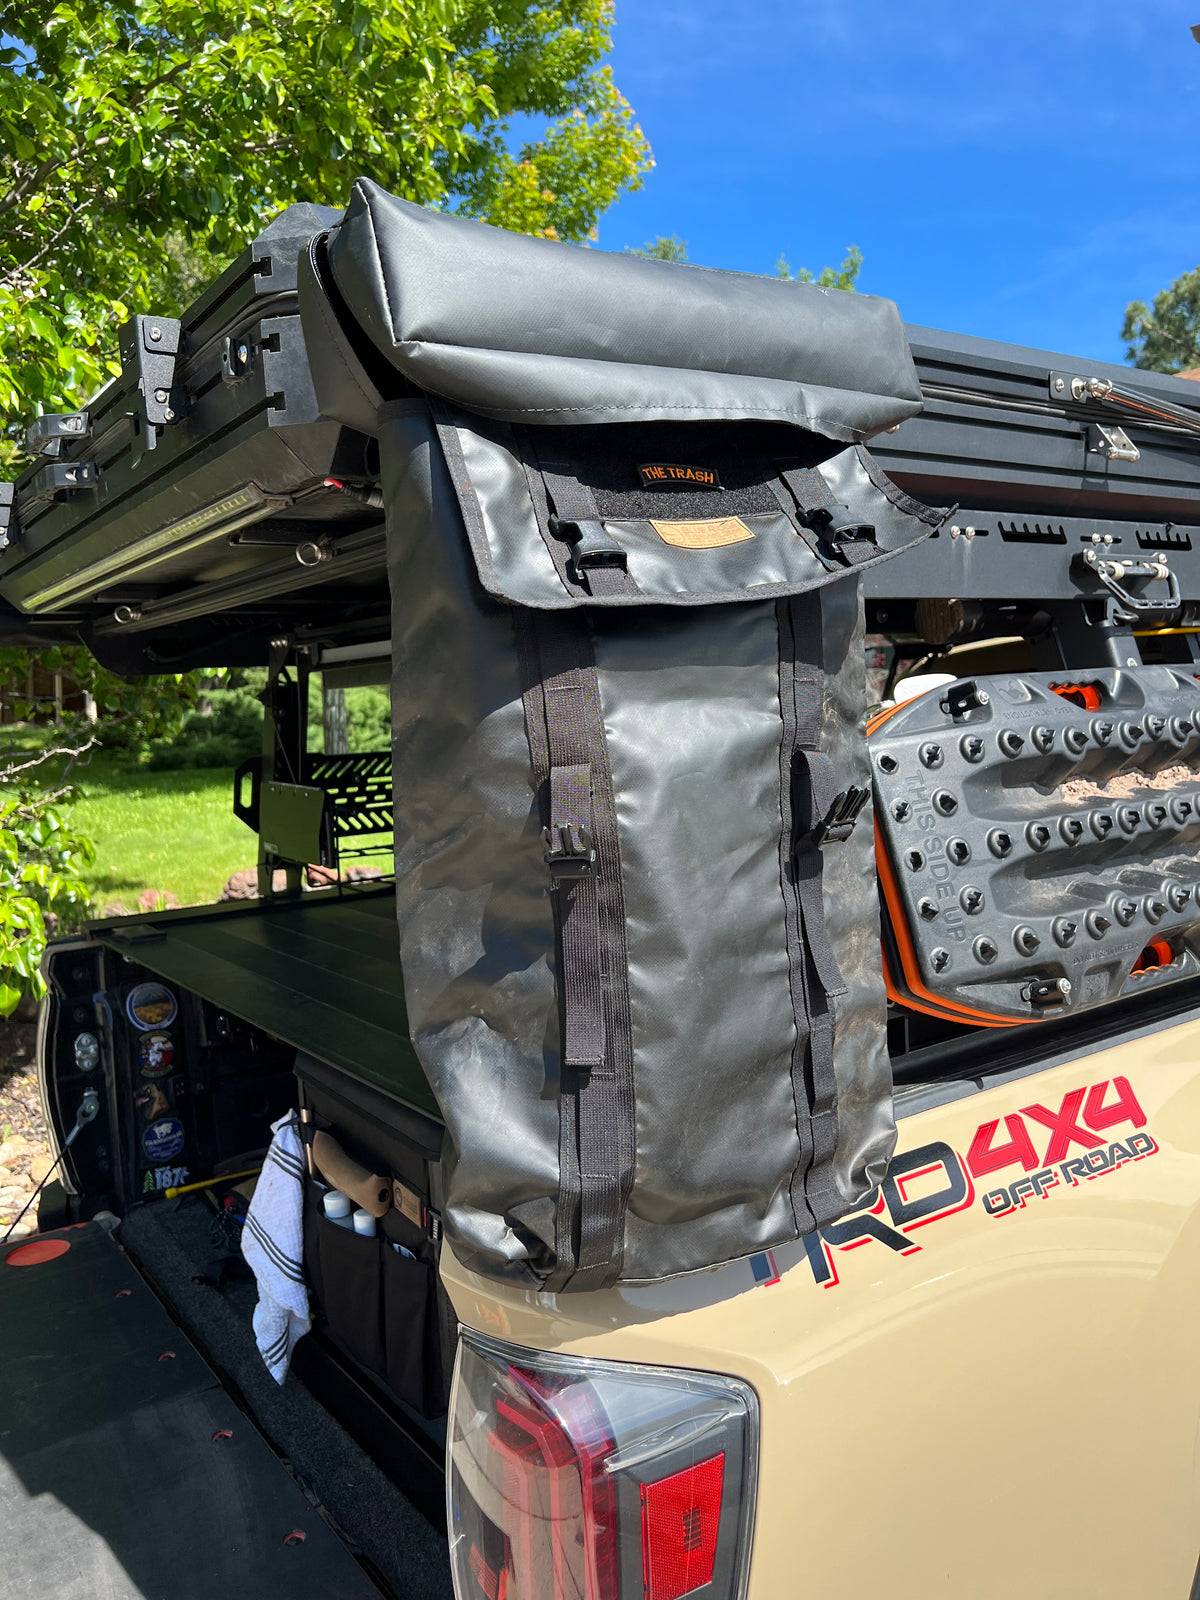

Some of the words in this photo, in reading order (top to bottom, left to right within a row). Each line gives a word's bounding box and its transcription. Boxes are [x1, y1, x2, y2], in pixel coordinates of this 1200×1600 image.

[642, 467, 667, 480] THE
[667, 467, 714, 484] TRASH
[904, 769, 938, 831] THIS
[923, 837, 956, 900] SIDE
[943, 905, 967, 942] UP
[749, 1141, 975, 1290] RD
[967, 1075, 1148, 1179] 4X4
[981, 1168, 1061, 1219] OFF
[1058, 1132, 1160, 1188] ROAD
